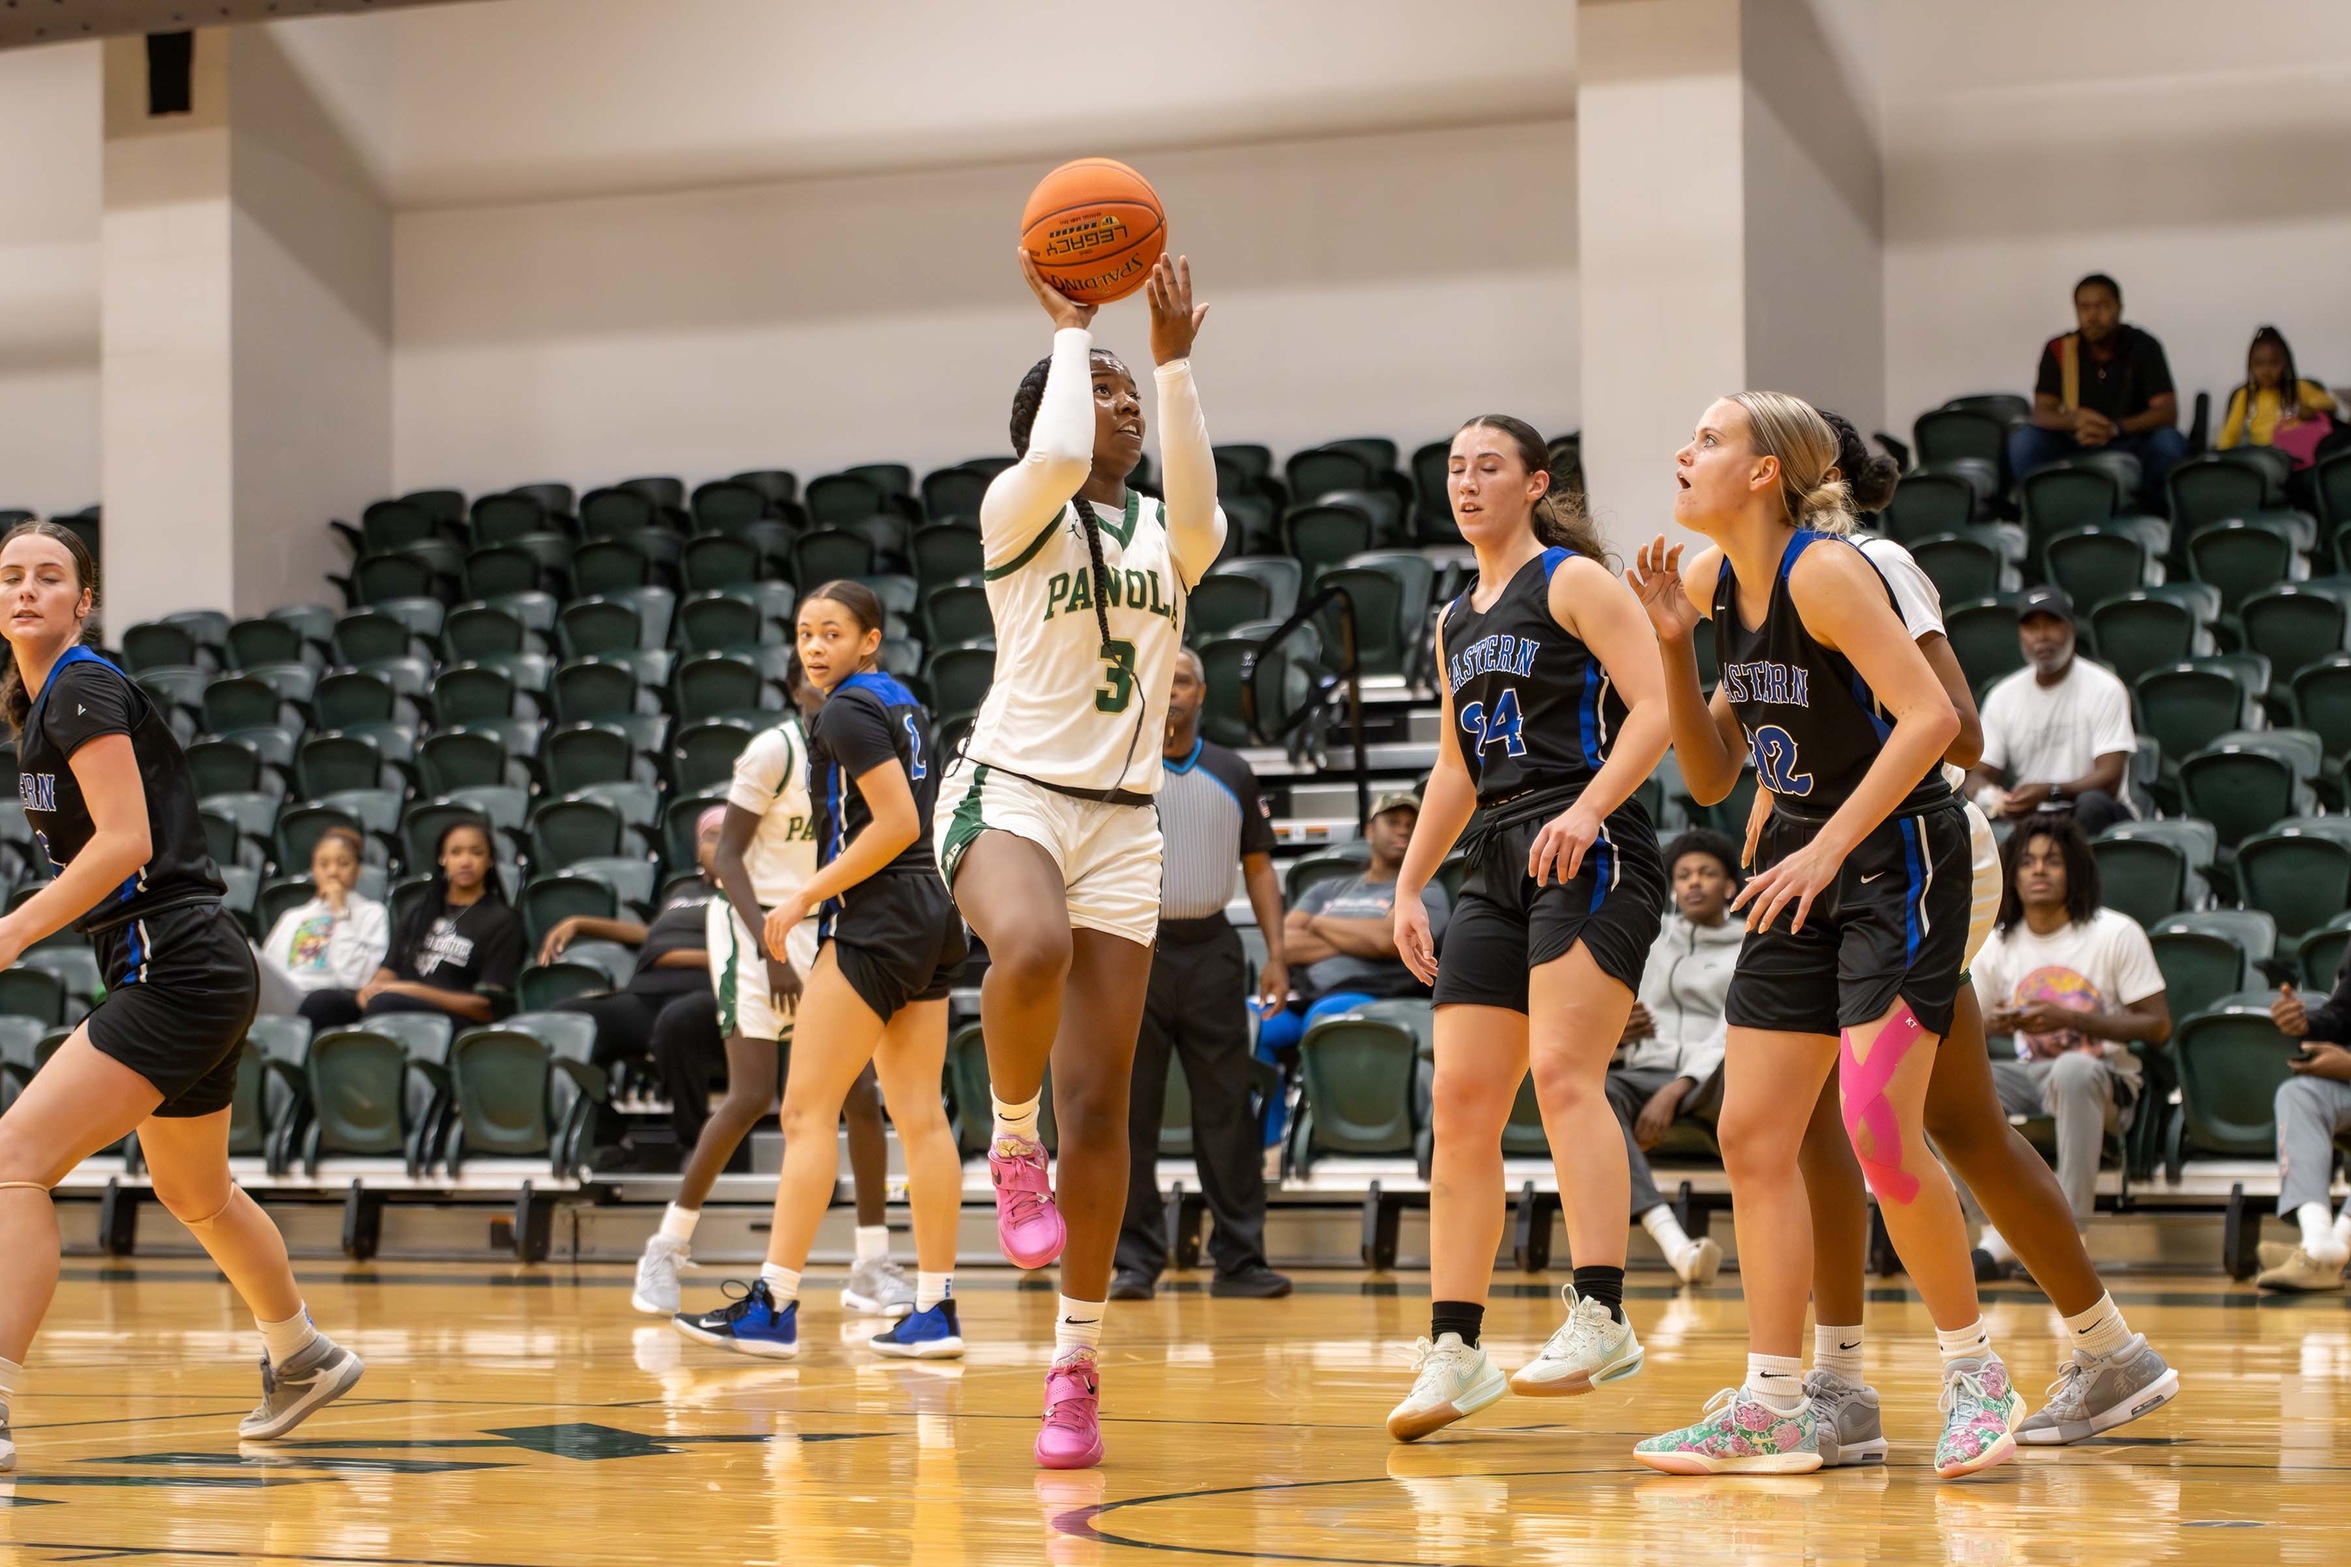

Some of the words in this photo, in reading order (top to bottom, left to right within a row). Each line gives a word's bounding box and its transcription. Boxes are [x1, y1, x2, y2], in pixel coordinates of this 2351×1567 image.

[1046, 224, 1129, 256] LEGACY
[1049, 252, 1145, 292] SPALDING
[1093, 637, 1139, 716] 3
[1449, 634, 1541, 698] ASTERN
[1742, 724, 1815, 797] 12
[20, 772, 57, 812] RN
[1905, 1016, 1918, 1029] KT
